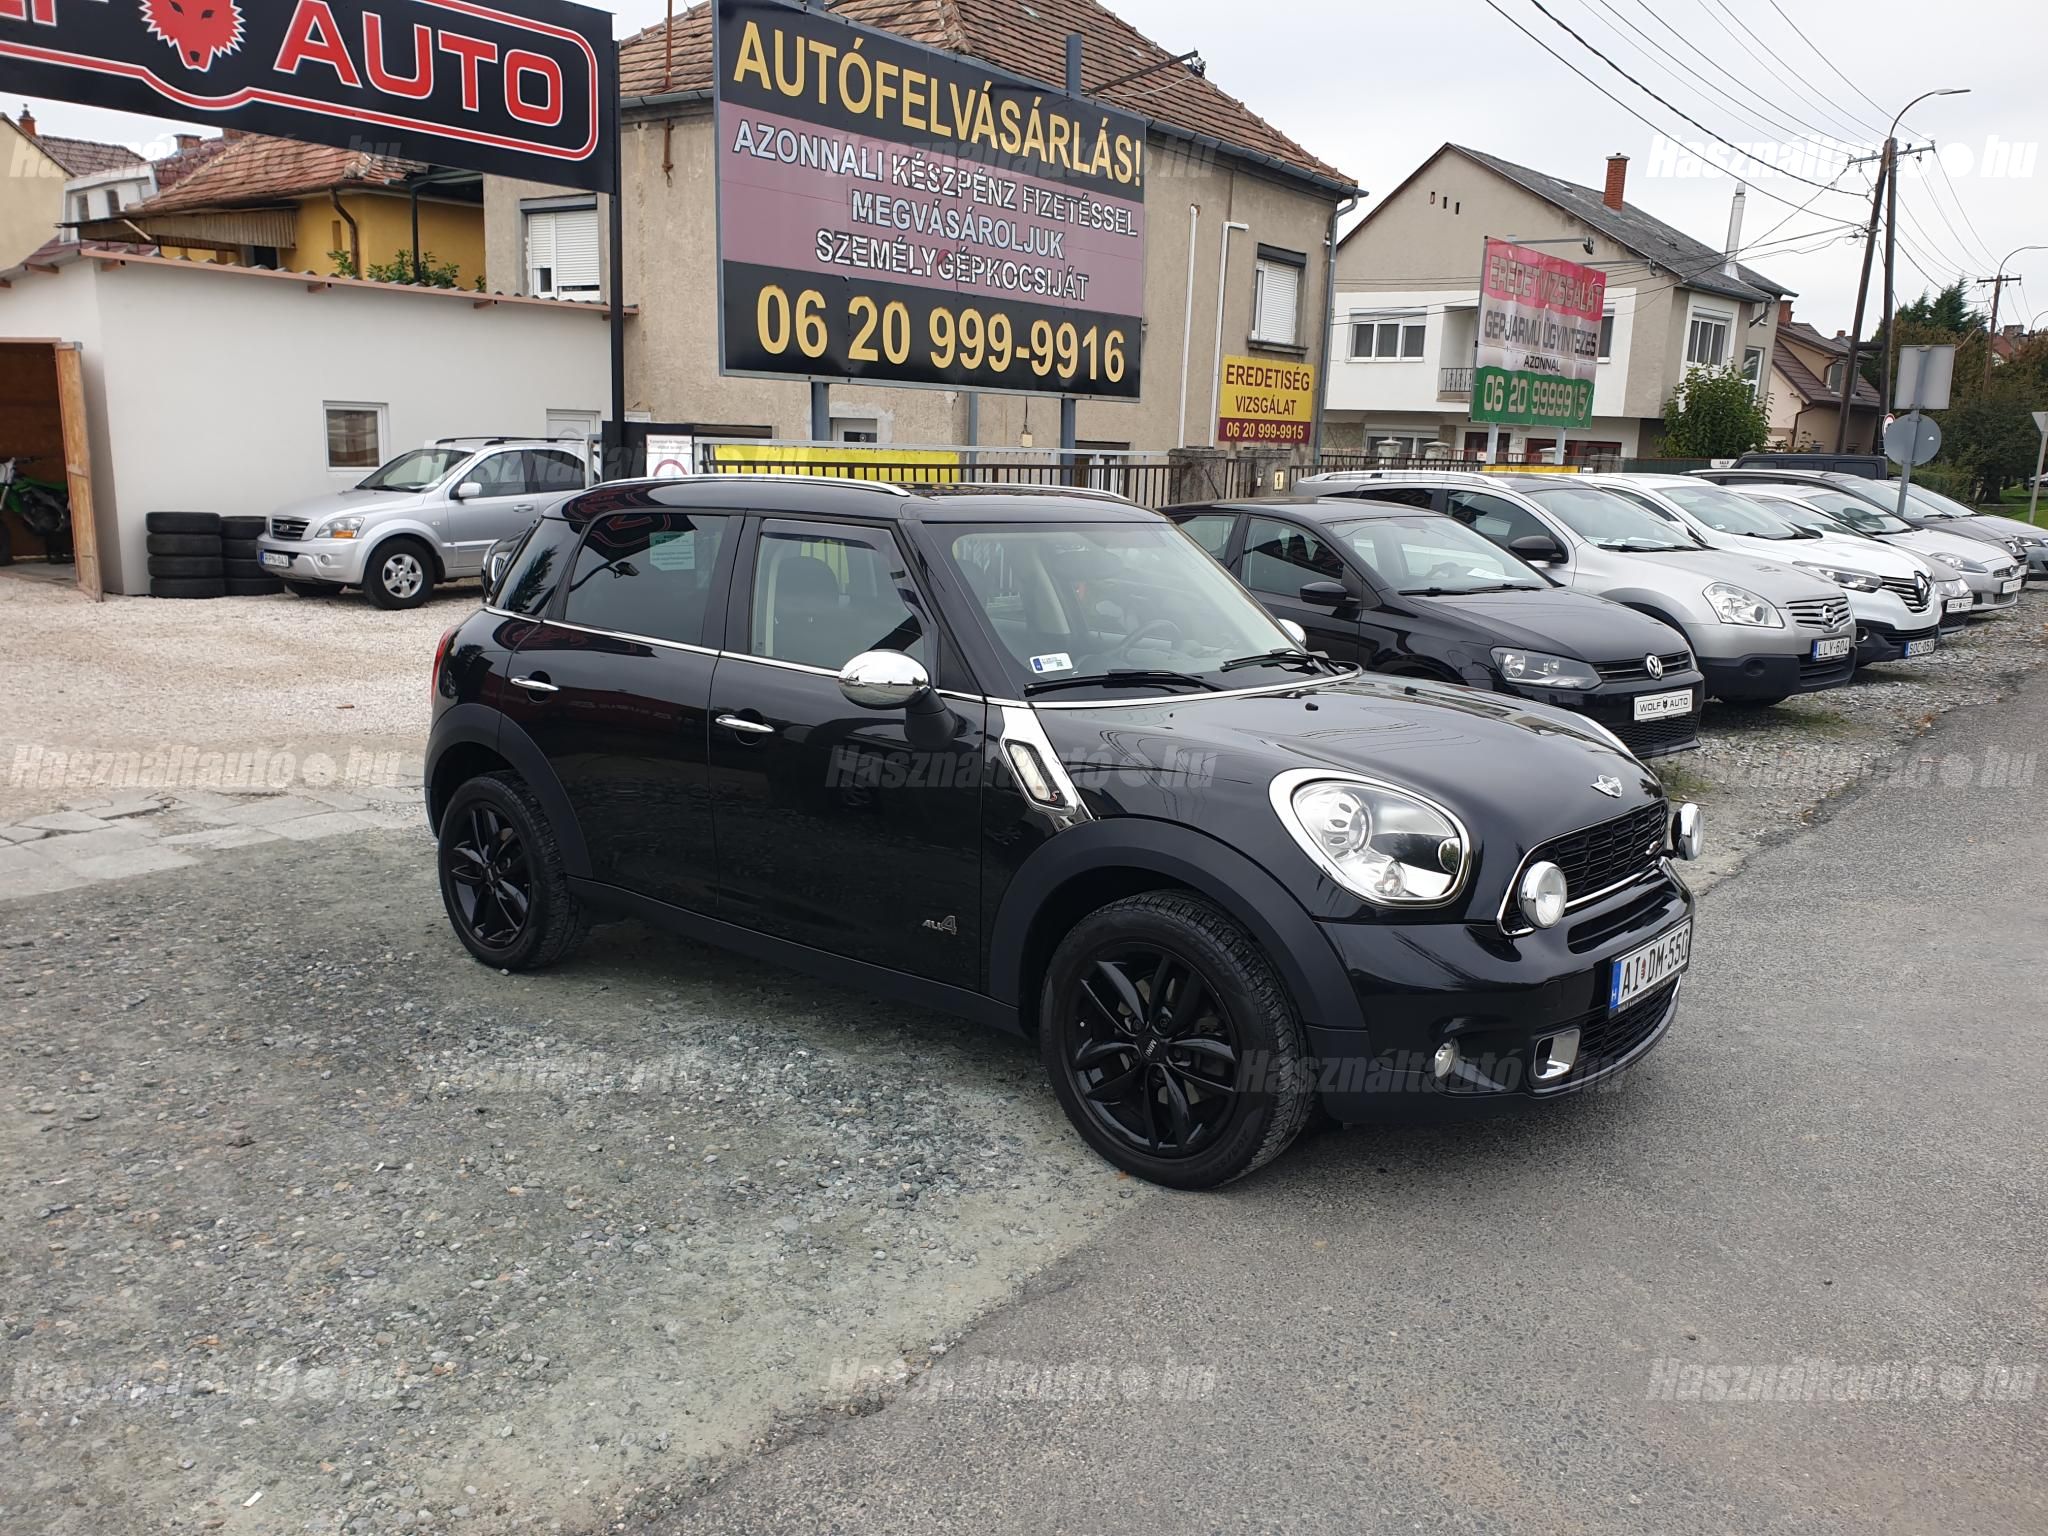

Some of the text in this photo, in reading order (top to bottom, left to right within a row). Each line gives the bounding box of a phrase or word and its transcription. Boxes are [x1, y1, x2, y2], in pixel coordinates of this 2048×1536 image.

[273, 0, 564, 127] AUTO
[733, 21, 1142, 187] AUTÓFELVÁSÁRLÁS!
[733, 119, 1138, 237] AZONNALI KÉSZPÉNZ FIZETÉSSEL
[852, 189, 1065, 259] MEGVÁSÁROLJUK
[815, 228, 1090, 301] SZEMÉLYGÉPKOCSIJÁT
[757, 284, 1125, 383] 06 20 999-9916
[1226, 364, 1310, 391] EREDETISÉG
[1484, 375, 1504, 412] 06
[1508, 376, 1527, 413] 20
[1226, 422, 1304, 439] 06 20 999-9915
[1235, 395, 1296, 416] VIZSGÁLAT
[1818, 640, 1848, 656] LLY-604
[1640, 697, 1688, 712] WOLF AUTO
